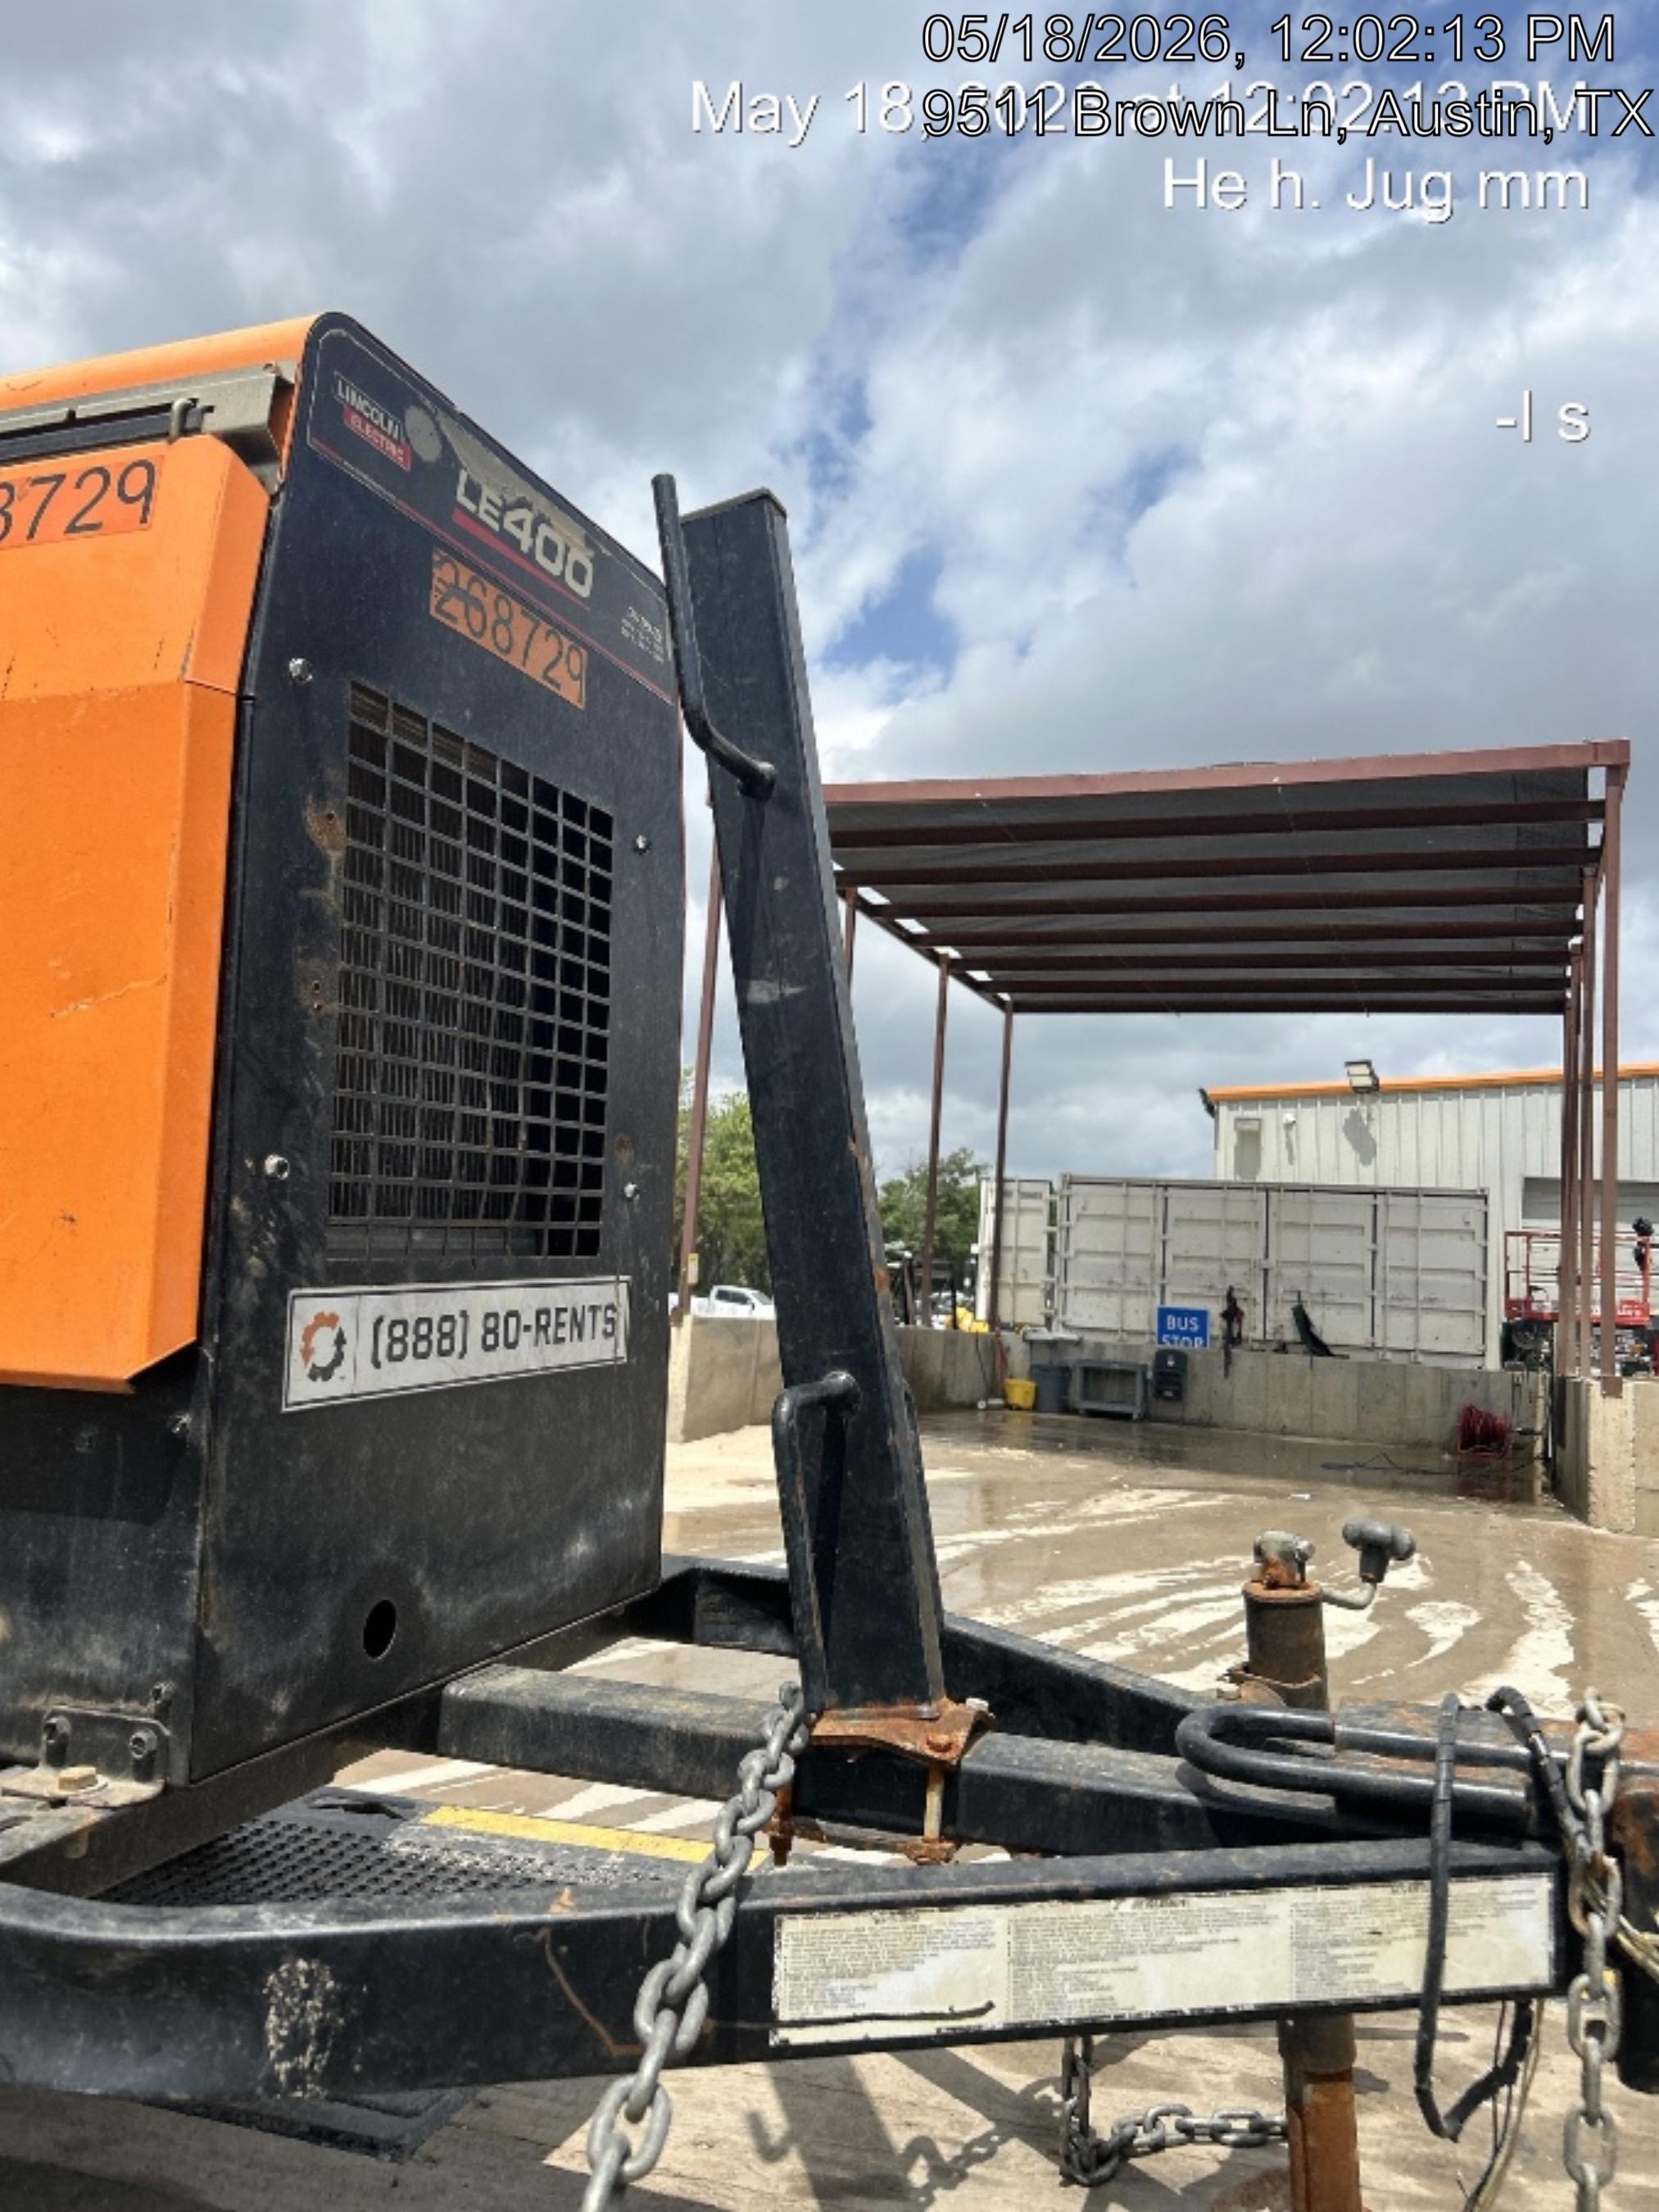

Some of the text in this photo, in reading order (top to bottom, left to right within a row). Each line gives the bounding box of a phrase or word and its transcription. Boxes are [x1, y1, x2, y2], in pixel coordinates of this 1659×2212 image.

[456, 468, 593, 598] LE400
[481, 1302, 618, 1353] 80-RENTS
[1166, 1313, 1199, 1333] BUS
